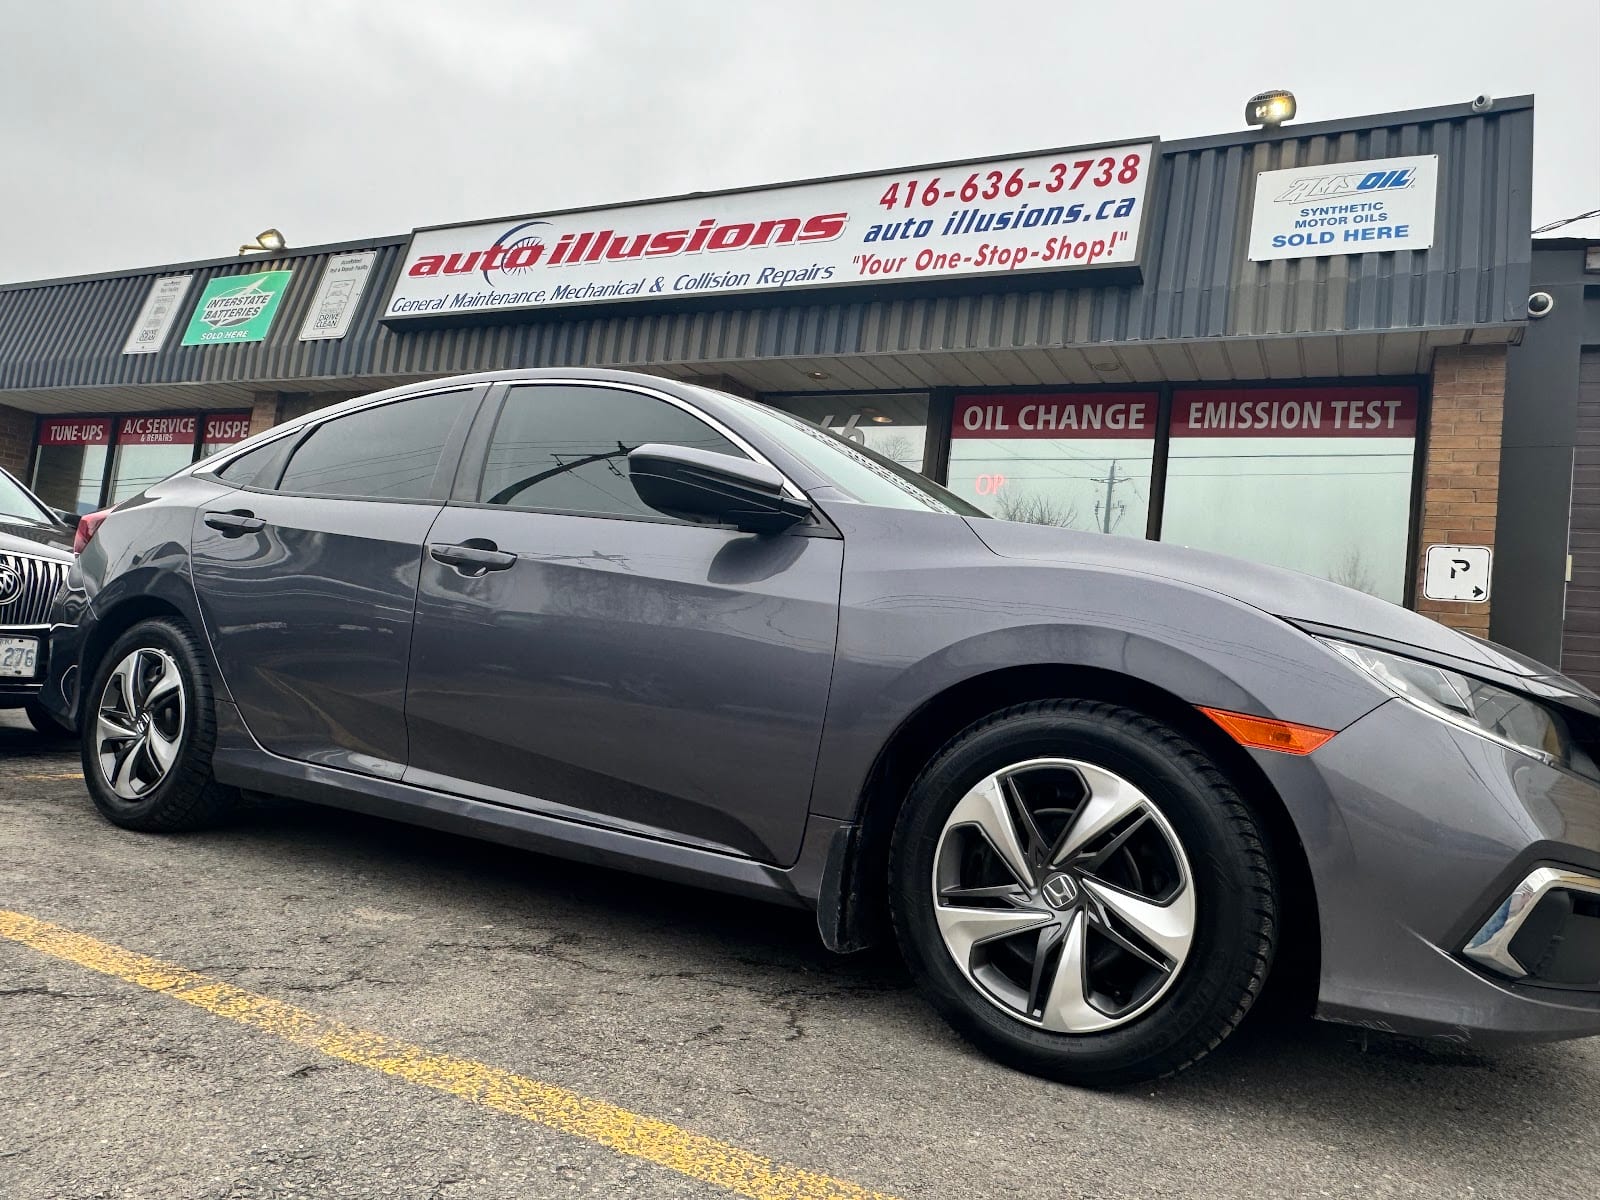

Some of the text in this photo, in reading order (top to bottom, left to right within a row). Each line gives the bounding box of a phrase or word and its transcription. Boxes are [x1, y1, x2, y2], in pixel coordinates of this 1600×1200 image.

[880, 153, 1140, 210] 416-636-3738
[1300, 202, 1384, 217] SYNTHETIC
[863, 197, 1137, 243] auto illusions.ca
[1294, 212, 1388, 229] MOTOR OILS
[408, 212, 849, 278] auto illusions
[1271, 225, 1409, 248] SOLD HERE
[853, 231, 1128, 276] "Your One-Stop-Shop!"
[389, 263, 836, 314] General Maintenance, Mechanical & Collision Repairs
[207, 294, 271, 309] INTERSTATE
[204, 307, 260, 320] BATTERIES
[201, 330, 248, 340] SOLD HERE
[963, 403, 1146, 430] OIL CHANGE
[1188, 400, 1402, 430] EMISSION TEST
[50, 424, 104, 441] TUNE-UPS
[123, 417, 196, 435] A/C SERVICE
[206, 420, 249, 438] SUSPE
[146, 433, 173, 442] REPAIRS
